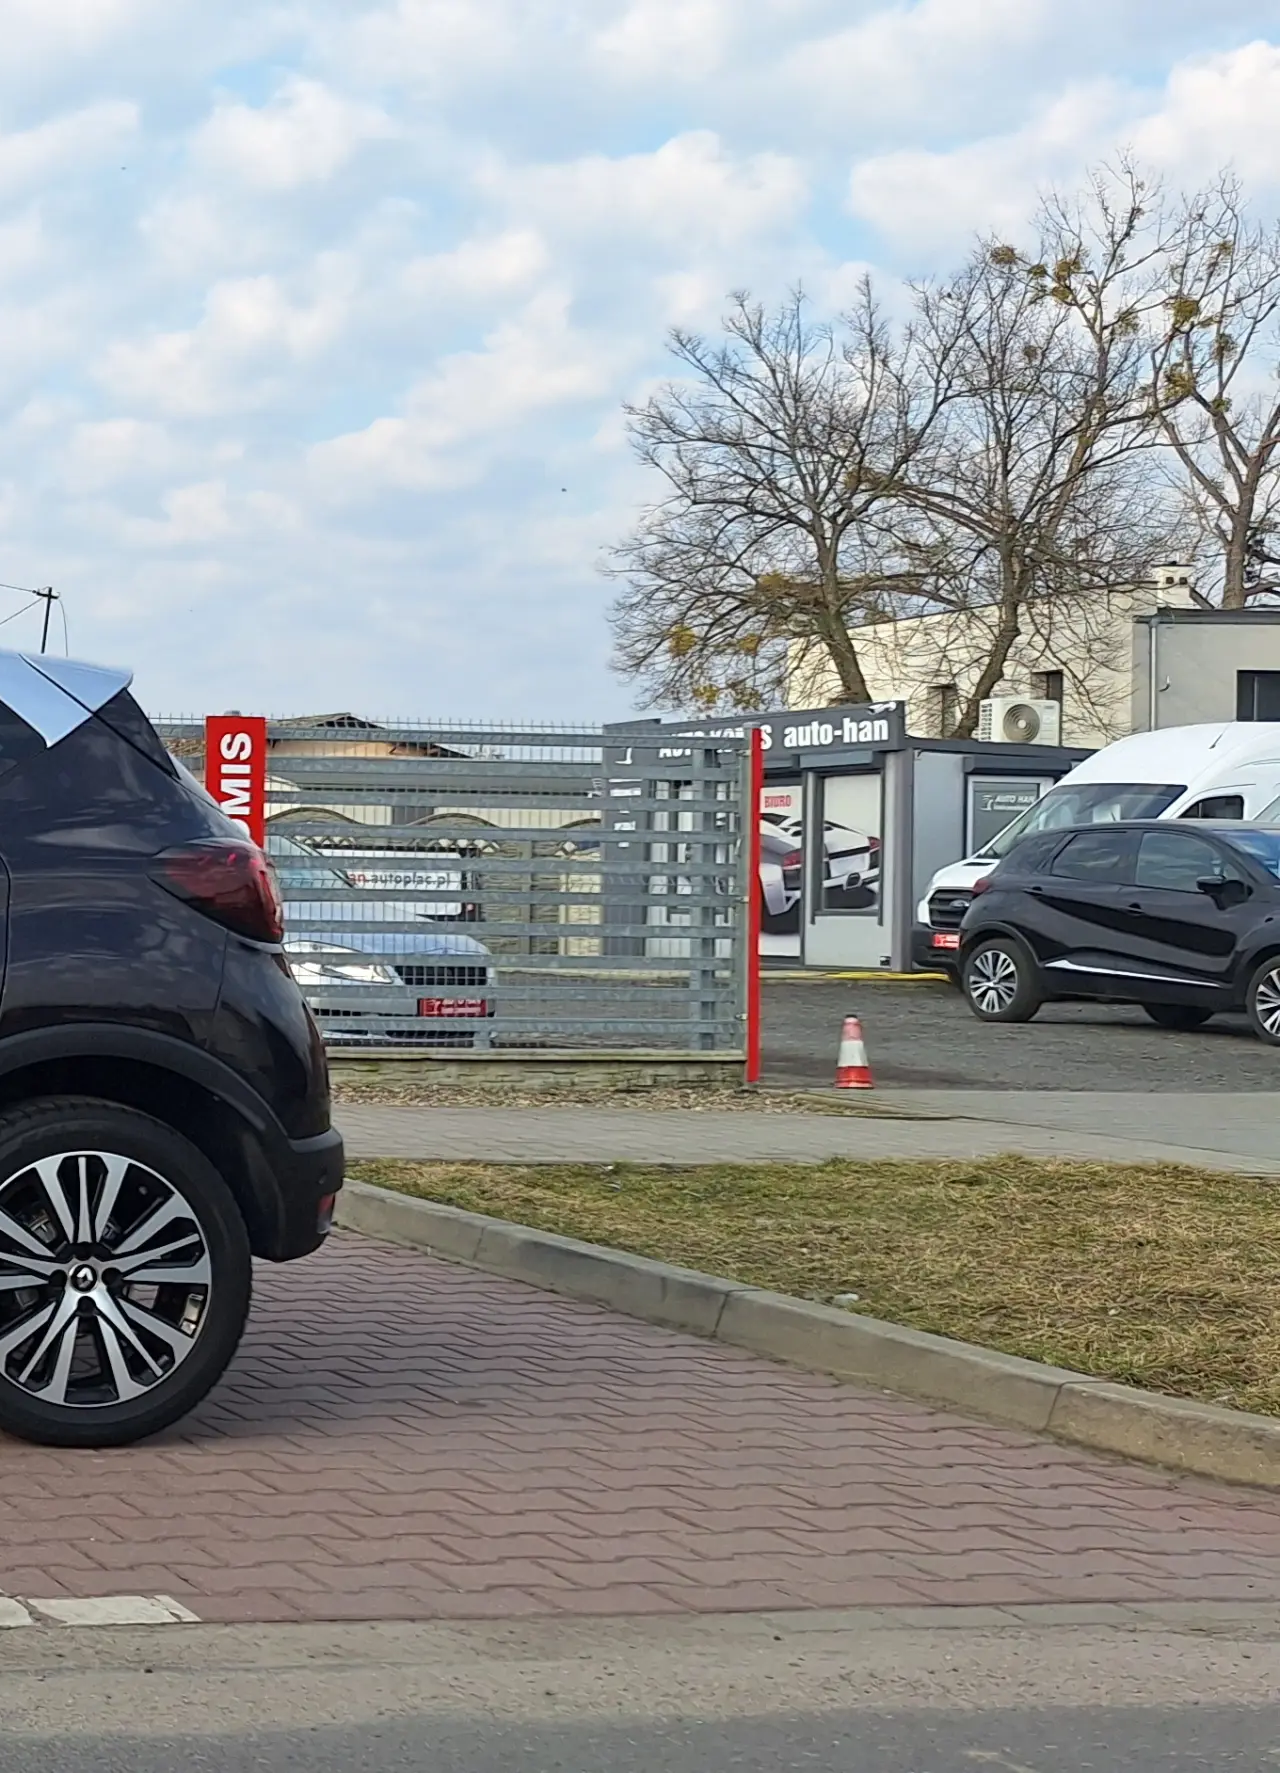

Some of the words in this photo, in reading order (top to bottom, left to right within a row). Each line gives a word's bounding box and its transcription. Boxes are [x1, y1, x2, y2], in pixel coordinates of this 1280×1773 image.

[783, 717, 889, 748] auto-han
[220, 732, 252, 836] MIS
[764, 795, 792, 808] BIURO
